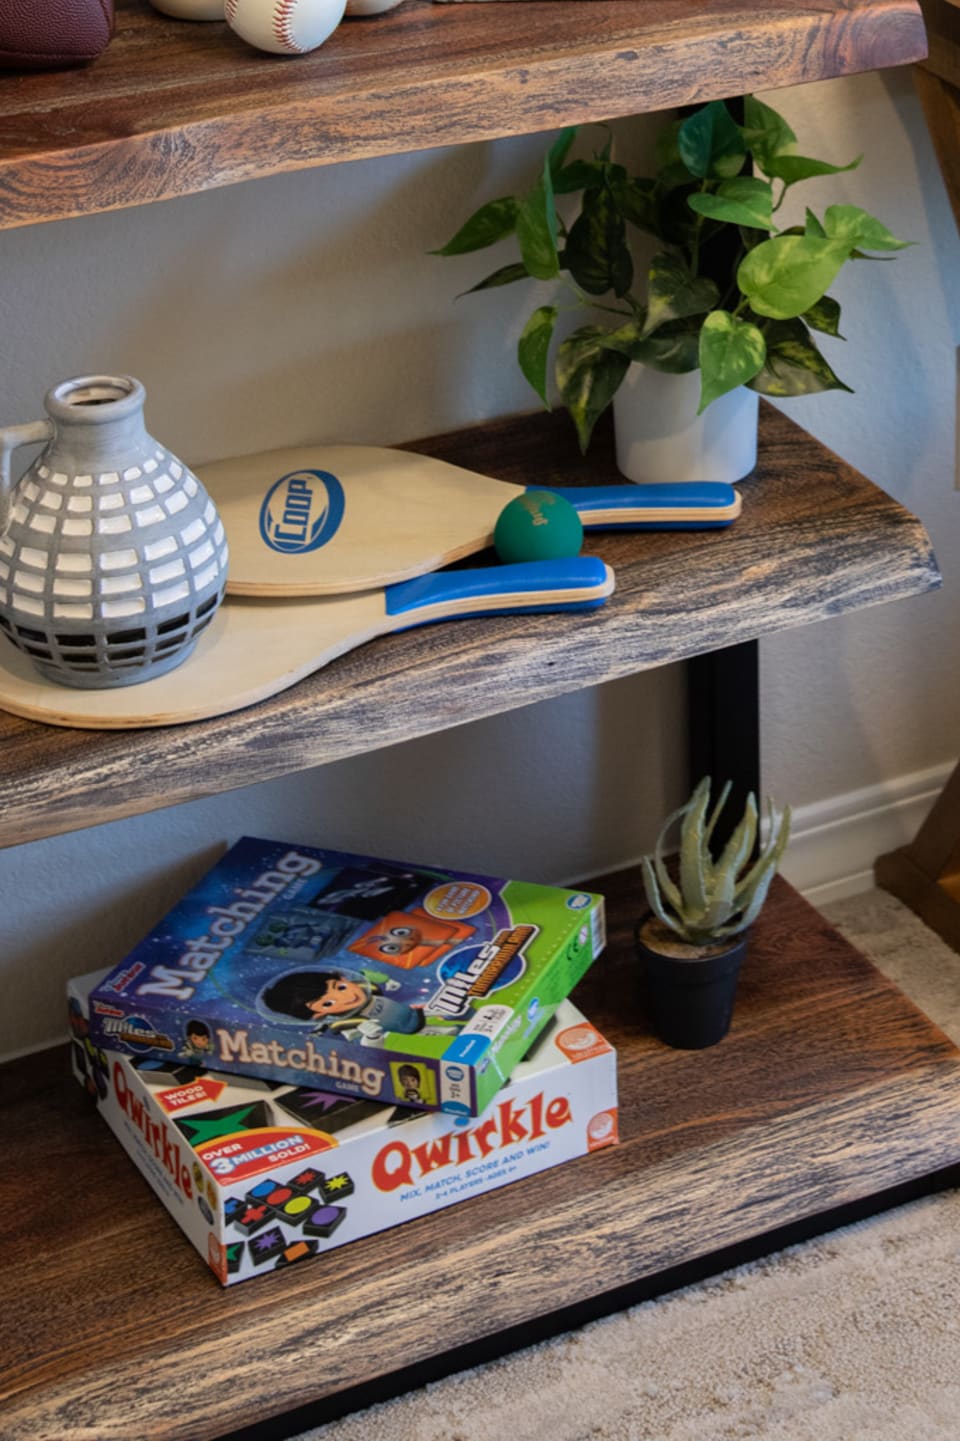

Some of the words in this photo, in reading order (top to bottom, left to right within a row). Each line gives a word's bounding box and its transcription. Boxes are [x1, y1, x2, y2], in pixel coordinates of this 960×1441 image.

[137, 851, 322, 1000] Matching
[216, 1029, 385, 1096] Matching
[164, 1085, 204, 1100] WOOD
[169, 1091, 208, 1106] TILES!
[202, 1143, 243, 1160] OVER
[209, 1157, 235, 1175] 3
[233, 1135, 305, 1166] MILLION
[268, 1143, 311, 1163] SOLD!
[371, 1091, 573, 1192] Qwirkle
[465, 1159, 499, 1178] SCORE
[502, 1150, 524, 1165] AND
